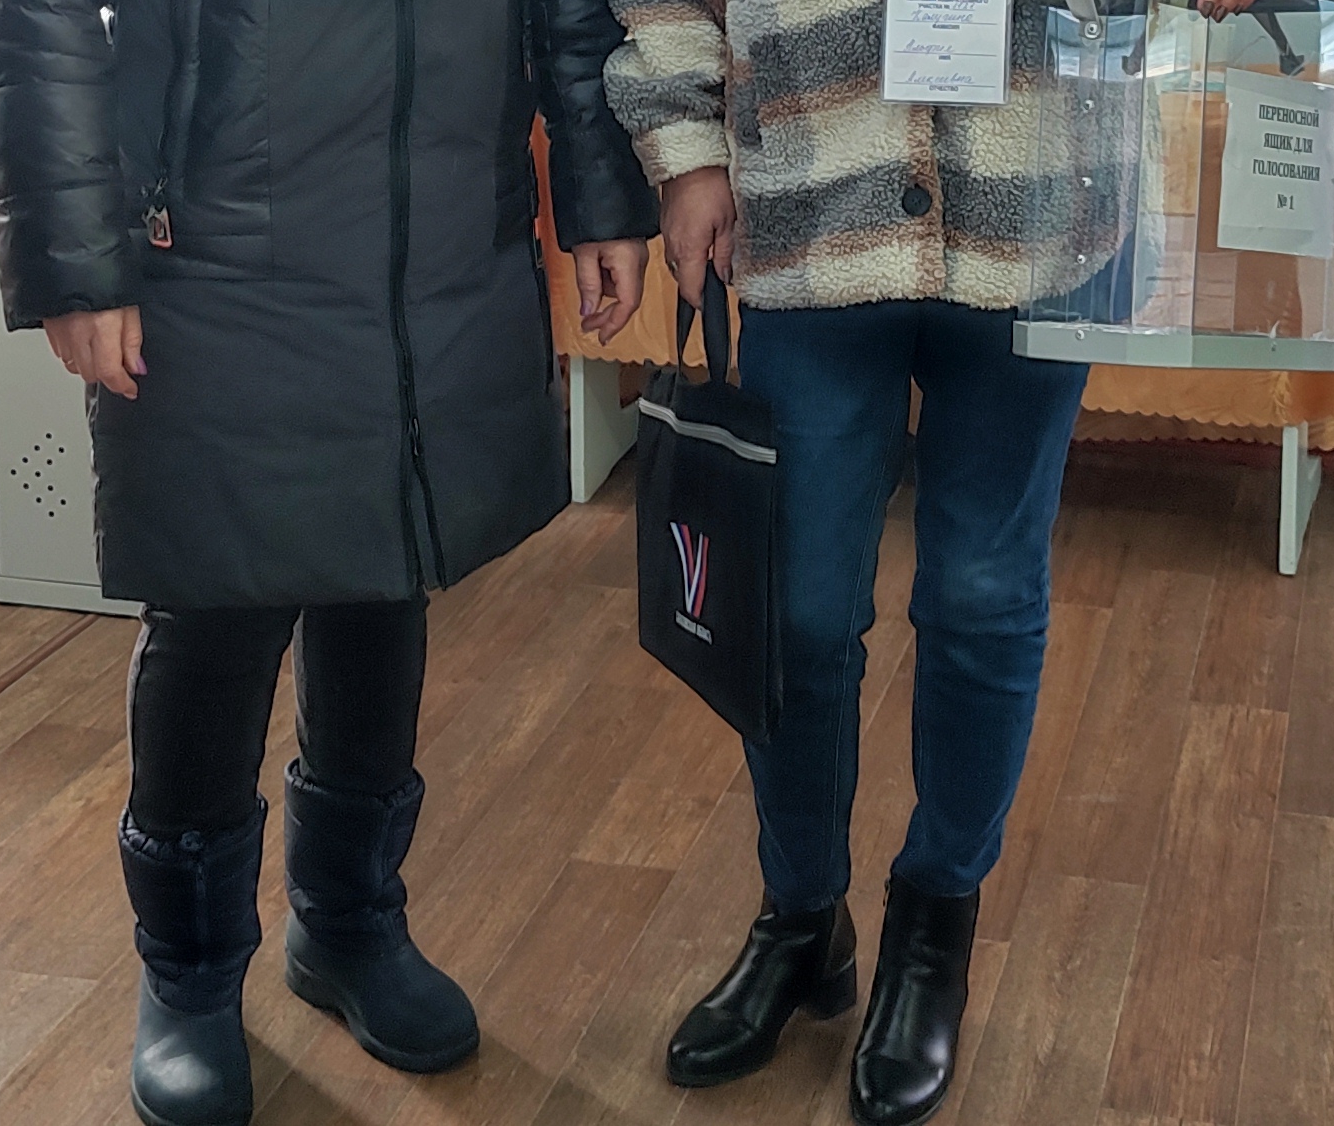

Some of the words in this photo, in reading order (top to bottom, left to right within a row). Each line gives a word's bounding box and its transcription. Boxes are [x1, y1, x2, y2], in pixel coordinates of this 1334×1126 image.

[1258, 104, 1320, 128] ПЕРЕНОСНОЙ
[1263, 132, 1293, 153] ЯЩИК
[1293, 136, 1314, 155] ДЛЯ
[1252, 158, 1321, 182] ГОЛОСОВАНИЯ
